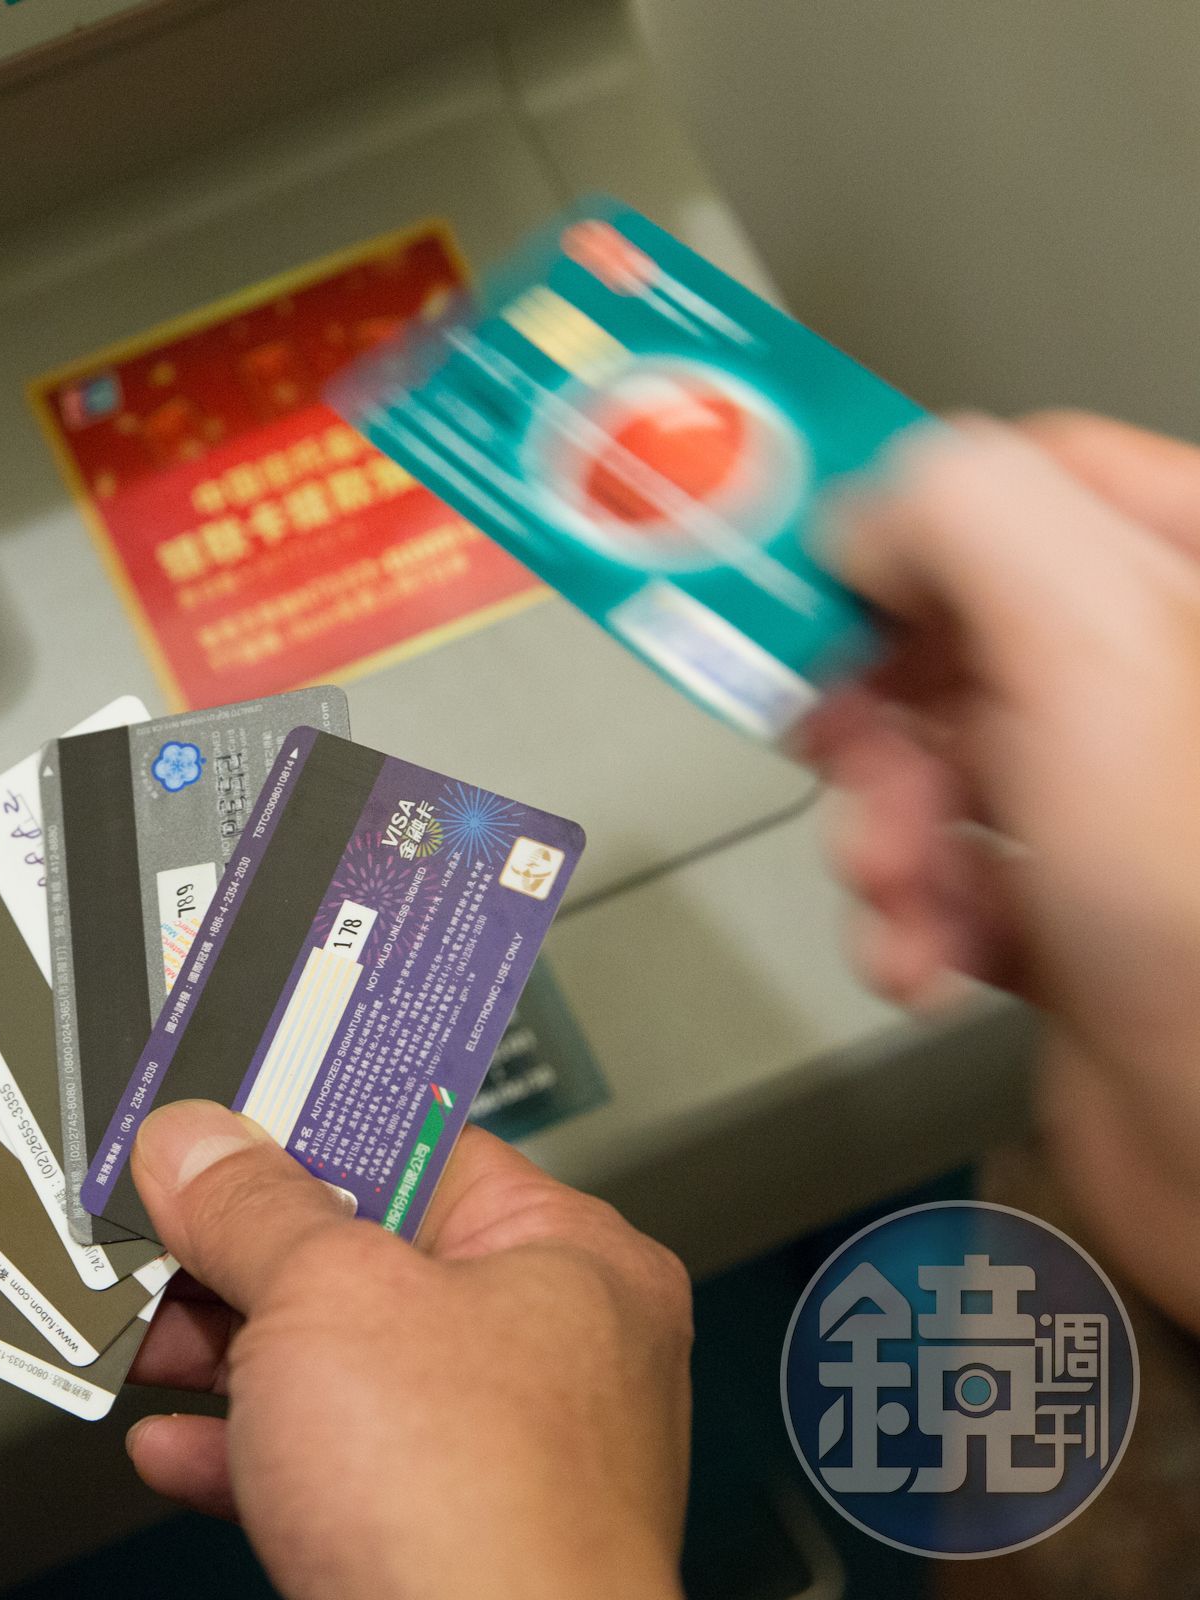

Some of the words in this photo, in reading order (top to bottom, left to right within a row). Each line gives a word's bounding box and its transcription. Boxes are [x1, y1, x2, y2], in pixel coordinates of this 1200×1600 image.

[321, 701, 330, 733] .com
[251, 758, 295, 840] TSTC0308010814
[380, 796, 416, 849] VISA
[395, 798, 437, 862] 金融卡
[175, 883, 196, 917] 789
[130, 1060, 159, 1109] 2354-2030
[207, 855, 252, 938] +886-4-2354-2030
[308, 1057, 343, 1120] AUTHORIZED
[336, 1001, 368, 1057] SIGNATURE
[365, 969, 382, 992] NOT
[375, 941, 394, 970] VALID
[387, 902, 411, 942] UNLESS
[404, 865, 427, 903] SIGNED
[464, 984, 502, 1052] ELECTRONIC
[494, 960, 512, 985] USE
[504, 931, 525, 961] ONLY
[7, 1277, 80, 1354] www.fubon.com
